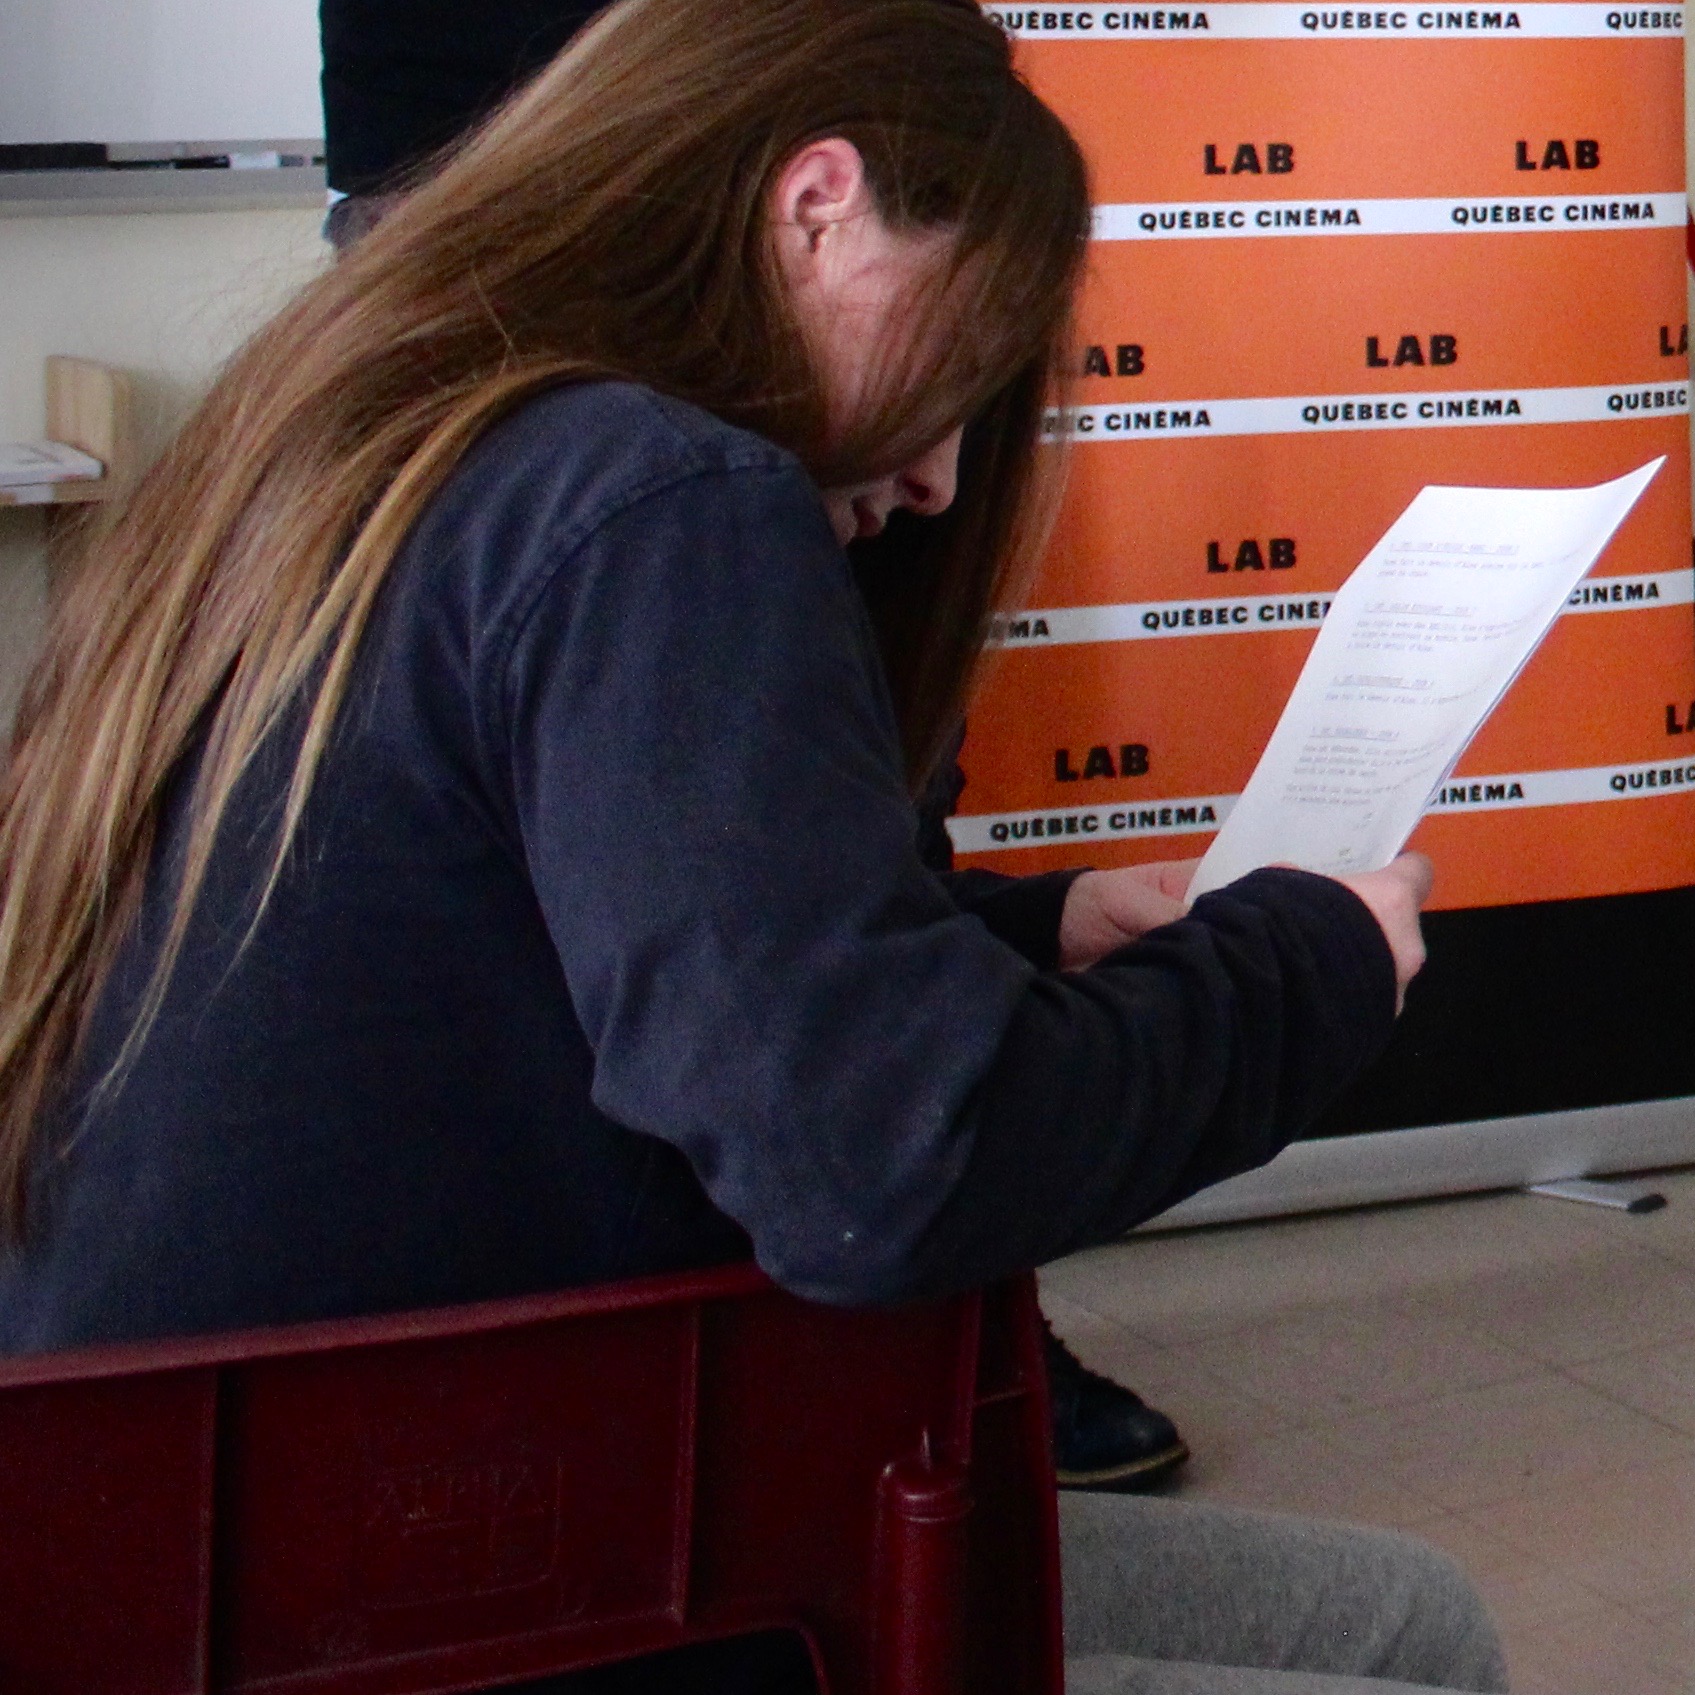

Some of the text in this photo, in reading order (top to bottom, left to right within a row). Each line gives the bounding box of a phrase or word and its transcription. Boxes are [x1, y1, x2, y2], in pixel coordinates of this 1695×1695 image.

[1103, 11, 1208, 29] CINÉMA
[1300, 11, 1520, 31] QUÉBEC CINÉMA
[1606, 10, 1682, 30] QUÉBEC
[1205, 143, 1293, 175] LAB
[1516, 140, 1599, 170] LAB
[1138, 208, 1360, 232] QUÉBEC CINÉMA
[1451, 203, 1654, 225] QUÉBEC CINÉMA
[1083, 345, 1145, 377] AB
[1367, 335, 1457, 368] LAB
[1302, 399, 1520, 424] QUÉBEC CINÉMA
[1607, 389, 1687, 412] QUÉBEC
[1104, 410, 1210, 431] CINÉMA
[1207, 539, 1296, 573] LAB
[1142, 600, 1331, 631] QUÉBEC CINÉ
[1054, 744, 1149, 783] LAB
[1431, 783, 1524, 805] INÉMA
[990, 806, 1215, 842] QUÉBEC CINÉMA
